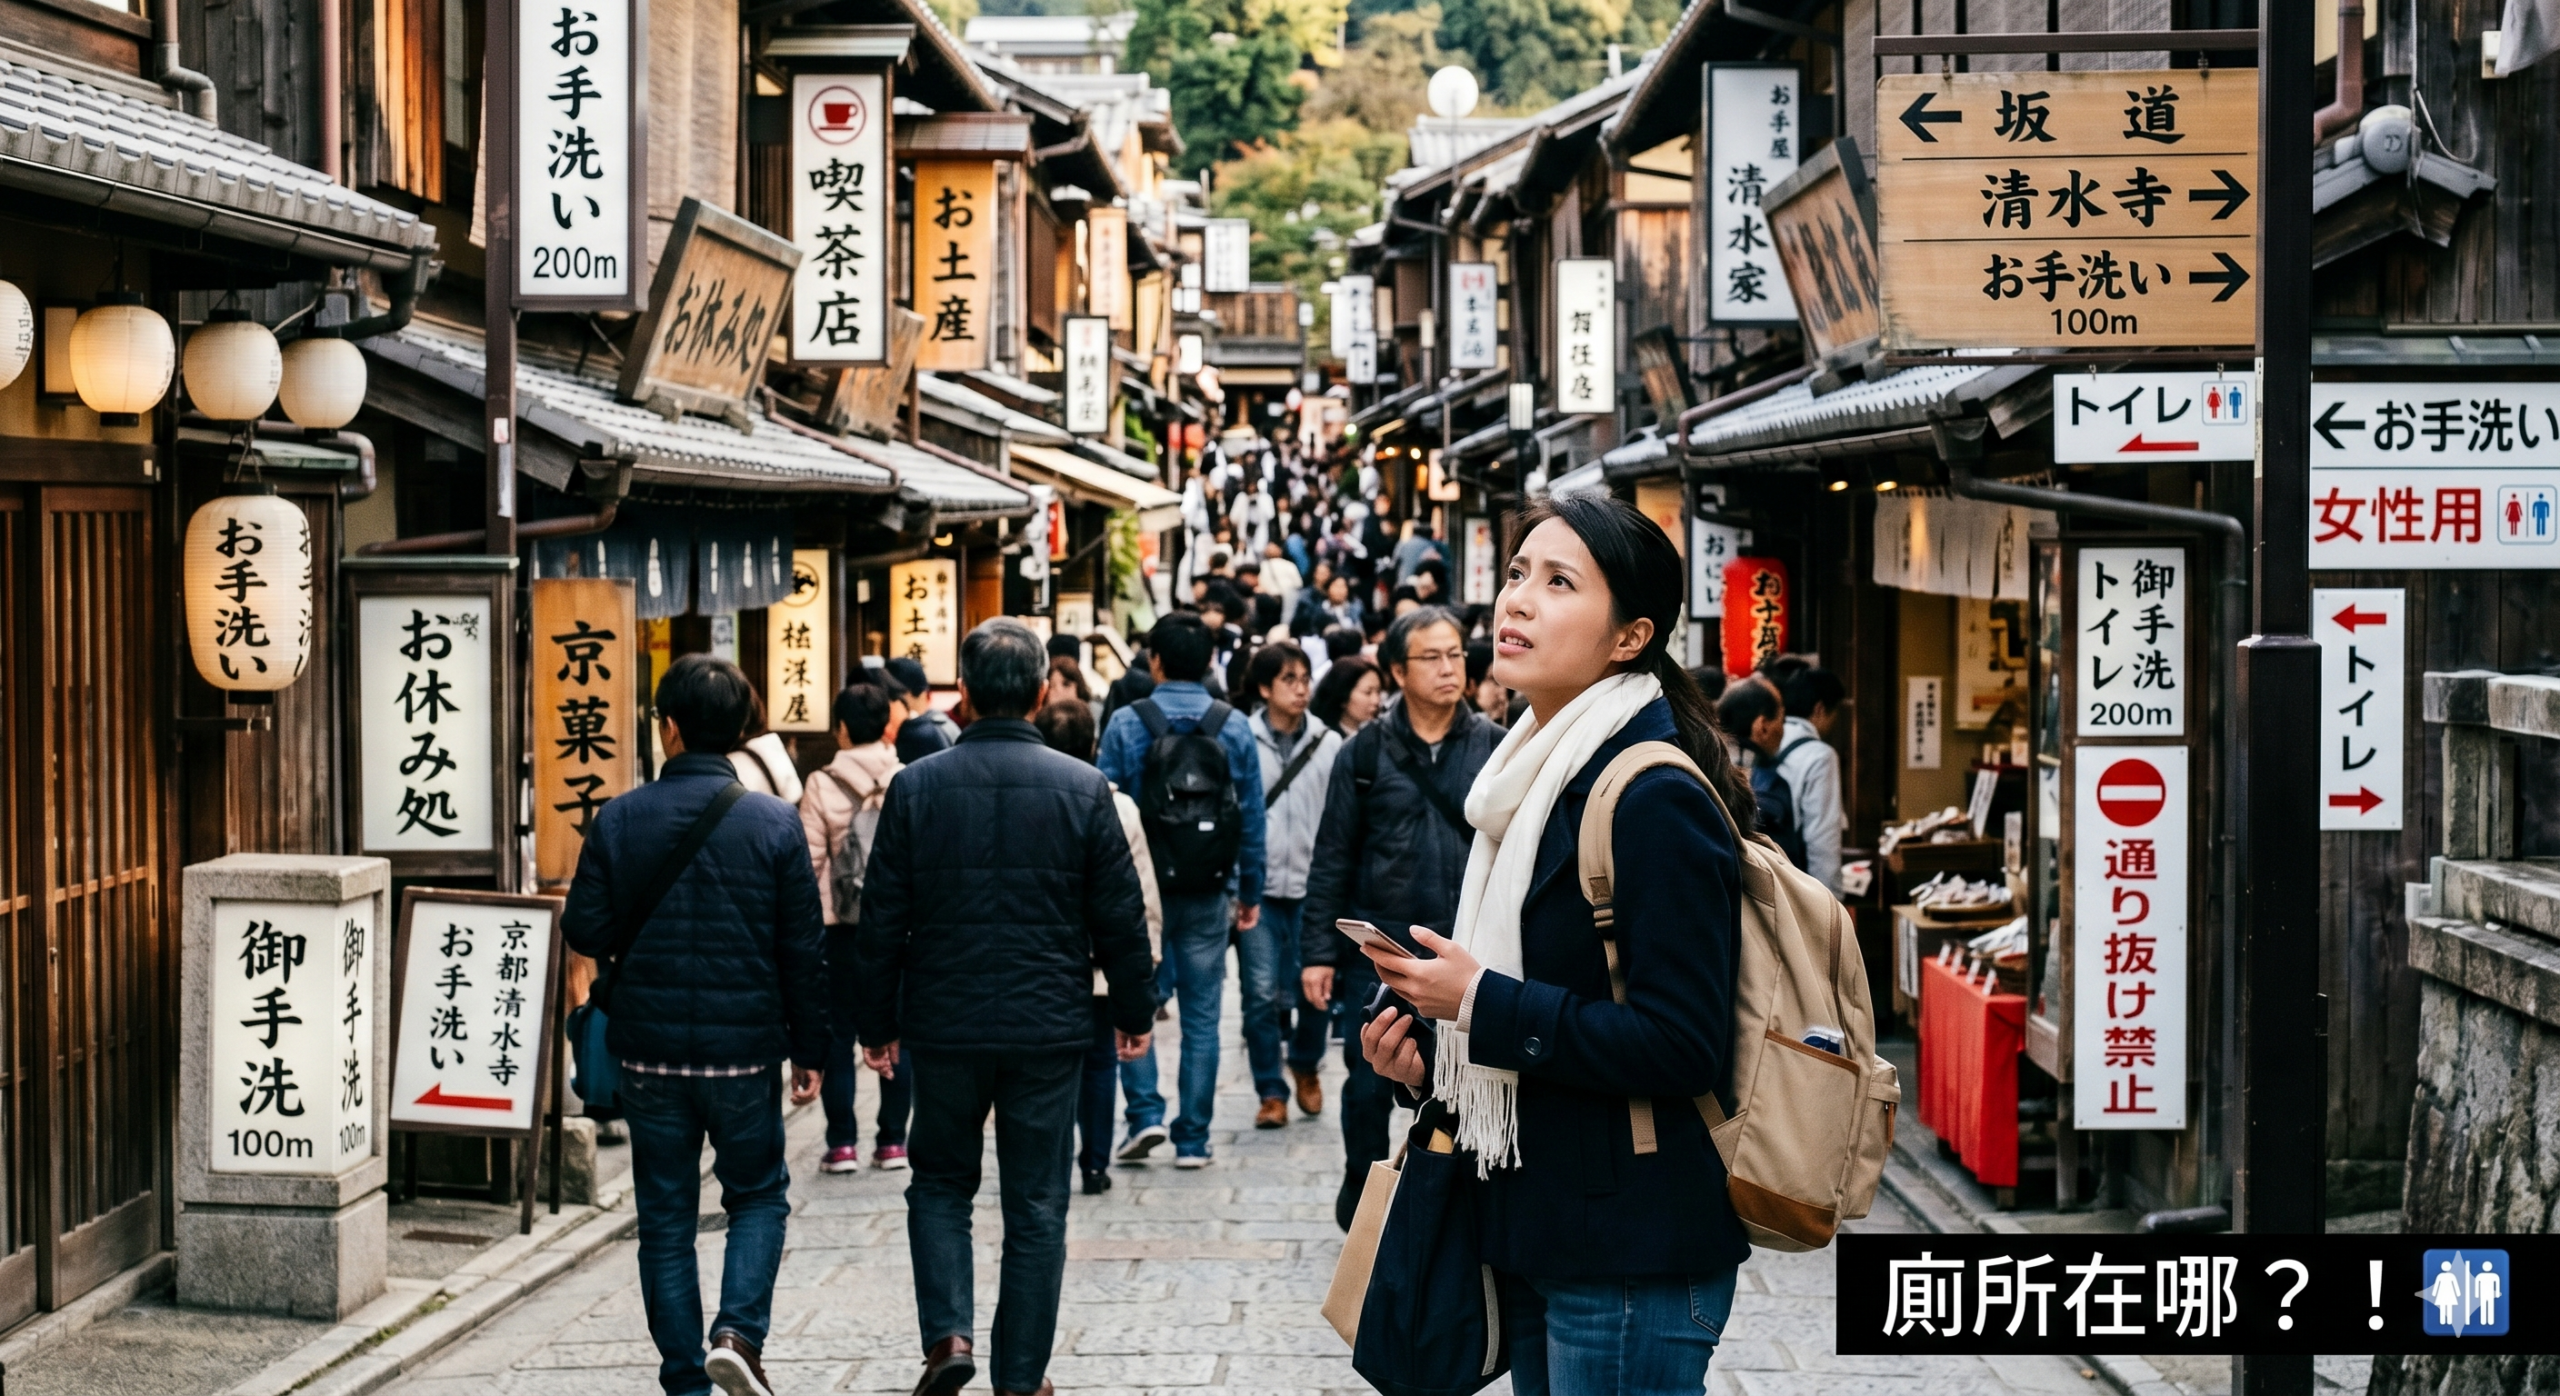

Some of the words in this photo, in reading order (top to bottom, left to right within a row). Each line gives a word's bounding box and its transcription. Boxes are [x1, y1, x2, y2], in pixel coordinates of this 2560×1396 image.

[549, 8, 603, 229] お手洗い
[1769, 84, 1791, 159] お手屋
[1994, 85, 2185, 144] 坂道
[809, 158, 865, 346] 喫茶店
[1727, 163, 1768, 304] 清水家
[1981, 167, 2172, 229] 清水寺
[534, 247, 616, 278] 200m
[929, 186, 976, 343] お土産
[1983, 250, 2171, 302] お手洗い
[2051, 309, 2137, 335] 100m
[2072, 387, 2191, 425] トイレ
[2374, 399, 2559, 451] お手洗い
[2314, 488, 2481, 543] 女性用
[215, 518, 270, 680] お手洗い
[2089, 562, 2122, 689] トイレ
[2133, 559, 2175, 689] 御手洗
[394, 609, 461, 837] お休み処
[551, 620, 616, 836] 京菓子
[2091, 703, 2171, 725] 200m
[2340, 646, 2376, 770] トイレ
[240, 921, 306, 1116] 御手洗
[343, 919, 364, 1109] 御手洗
[431, 924, 473, 1069] お手洗い
[489, 921, 531, 1086] 京都清水寺
[2105, 840, 2155, 1112] 通り抜け禁止
[228, 1130, 312, 1157] 100m
[340, 1123, 364, 1152] 100m
